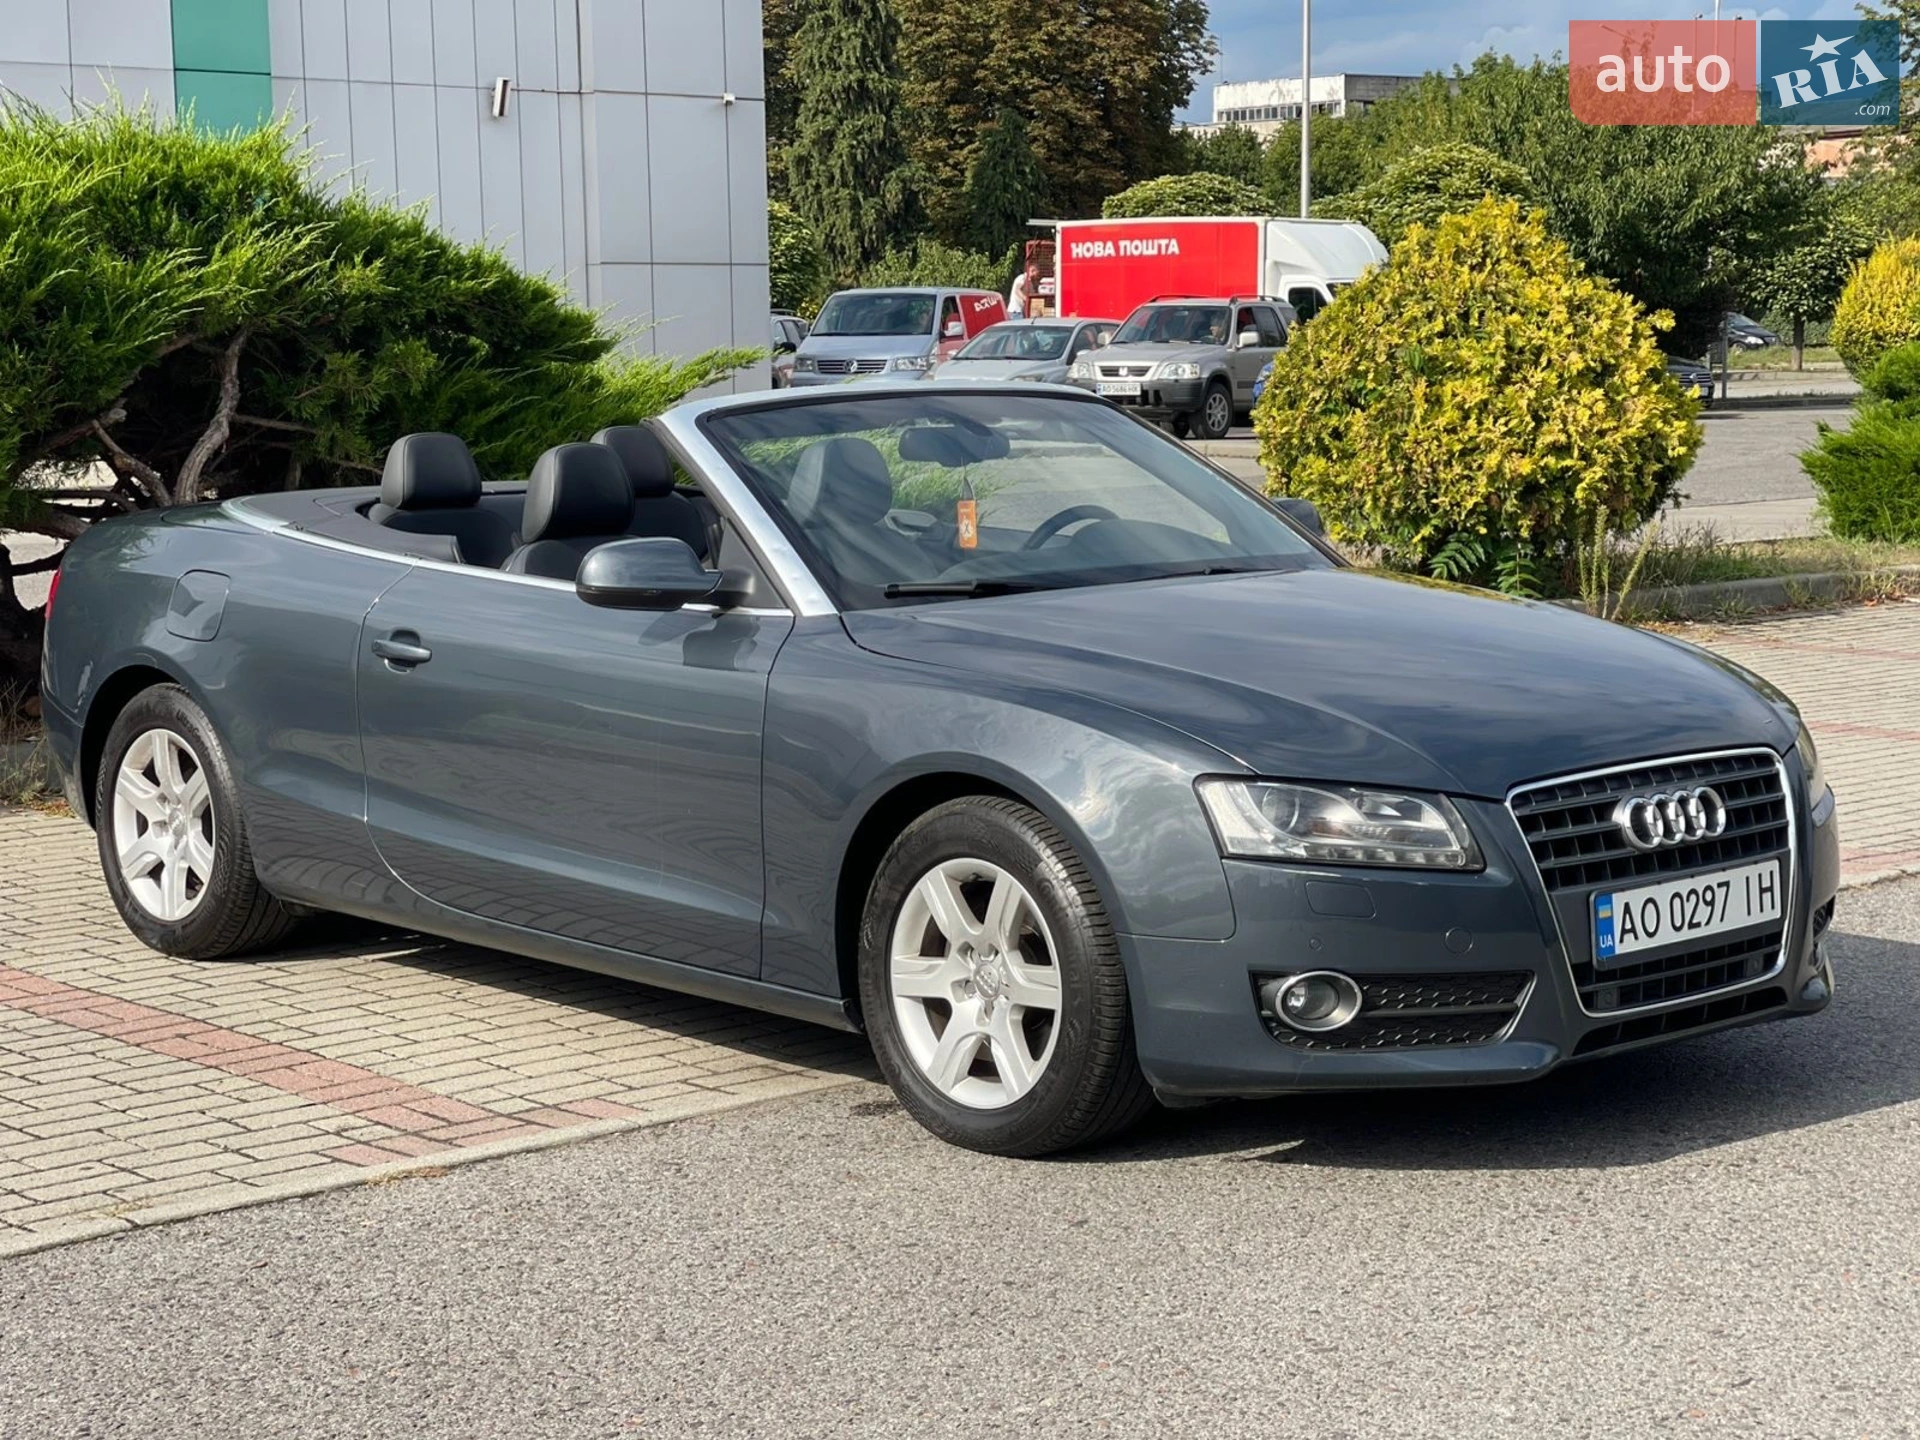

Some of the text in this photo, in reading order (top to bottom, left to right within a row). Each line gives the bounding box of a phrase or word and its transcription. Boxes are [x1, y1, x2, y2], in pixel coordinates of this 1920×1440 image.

[1070, 238, 1180, 259] НОВА ПОШТА
[1618, 896, 1661, 945] AO
[1669, 880, 1731, 933] 0297
[1600, 935, 1614, 949] UA
